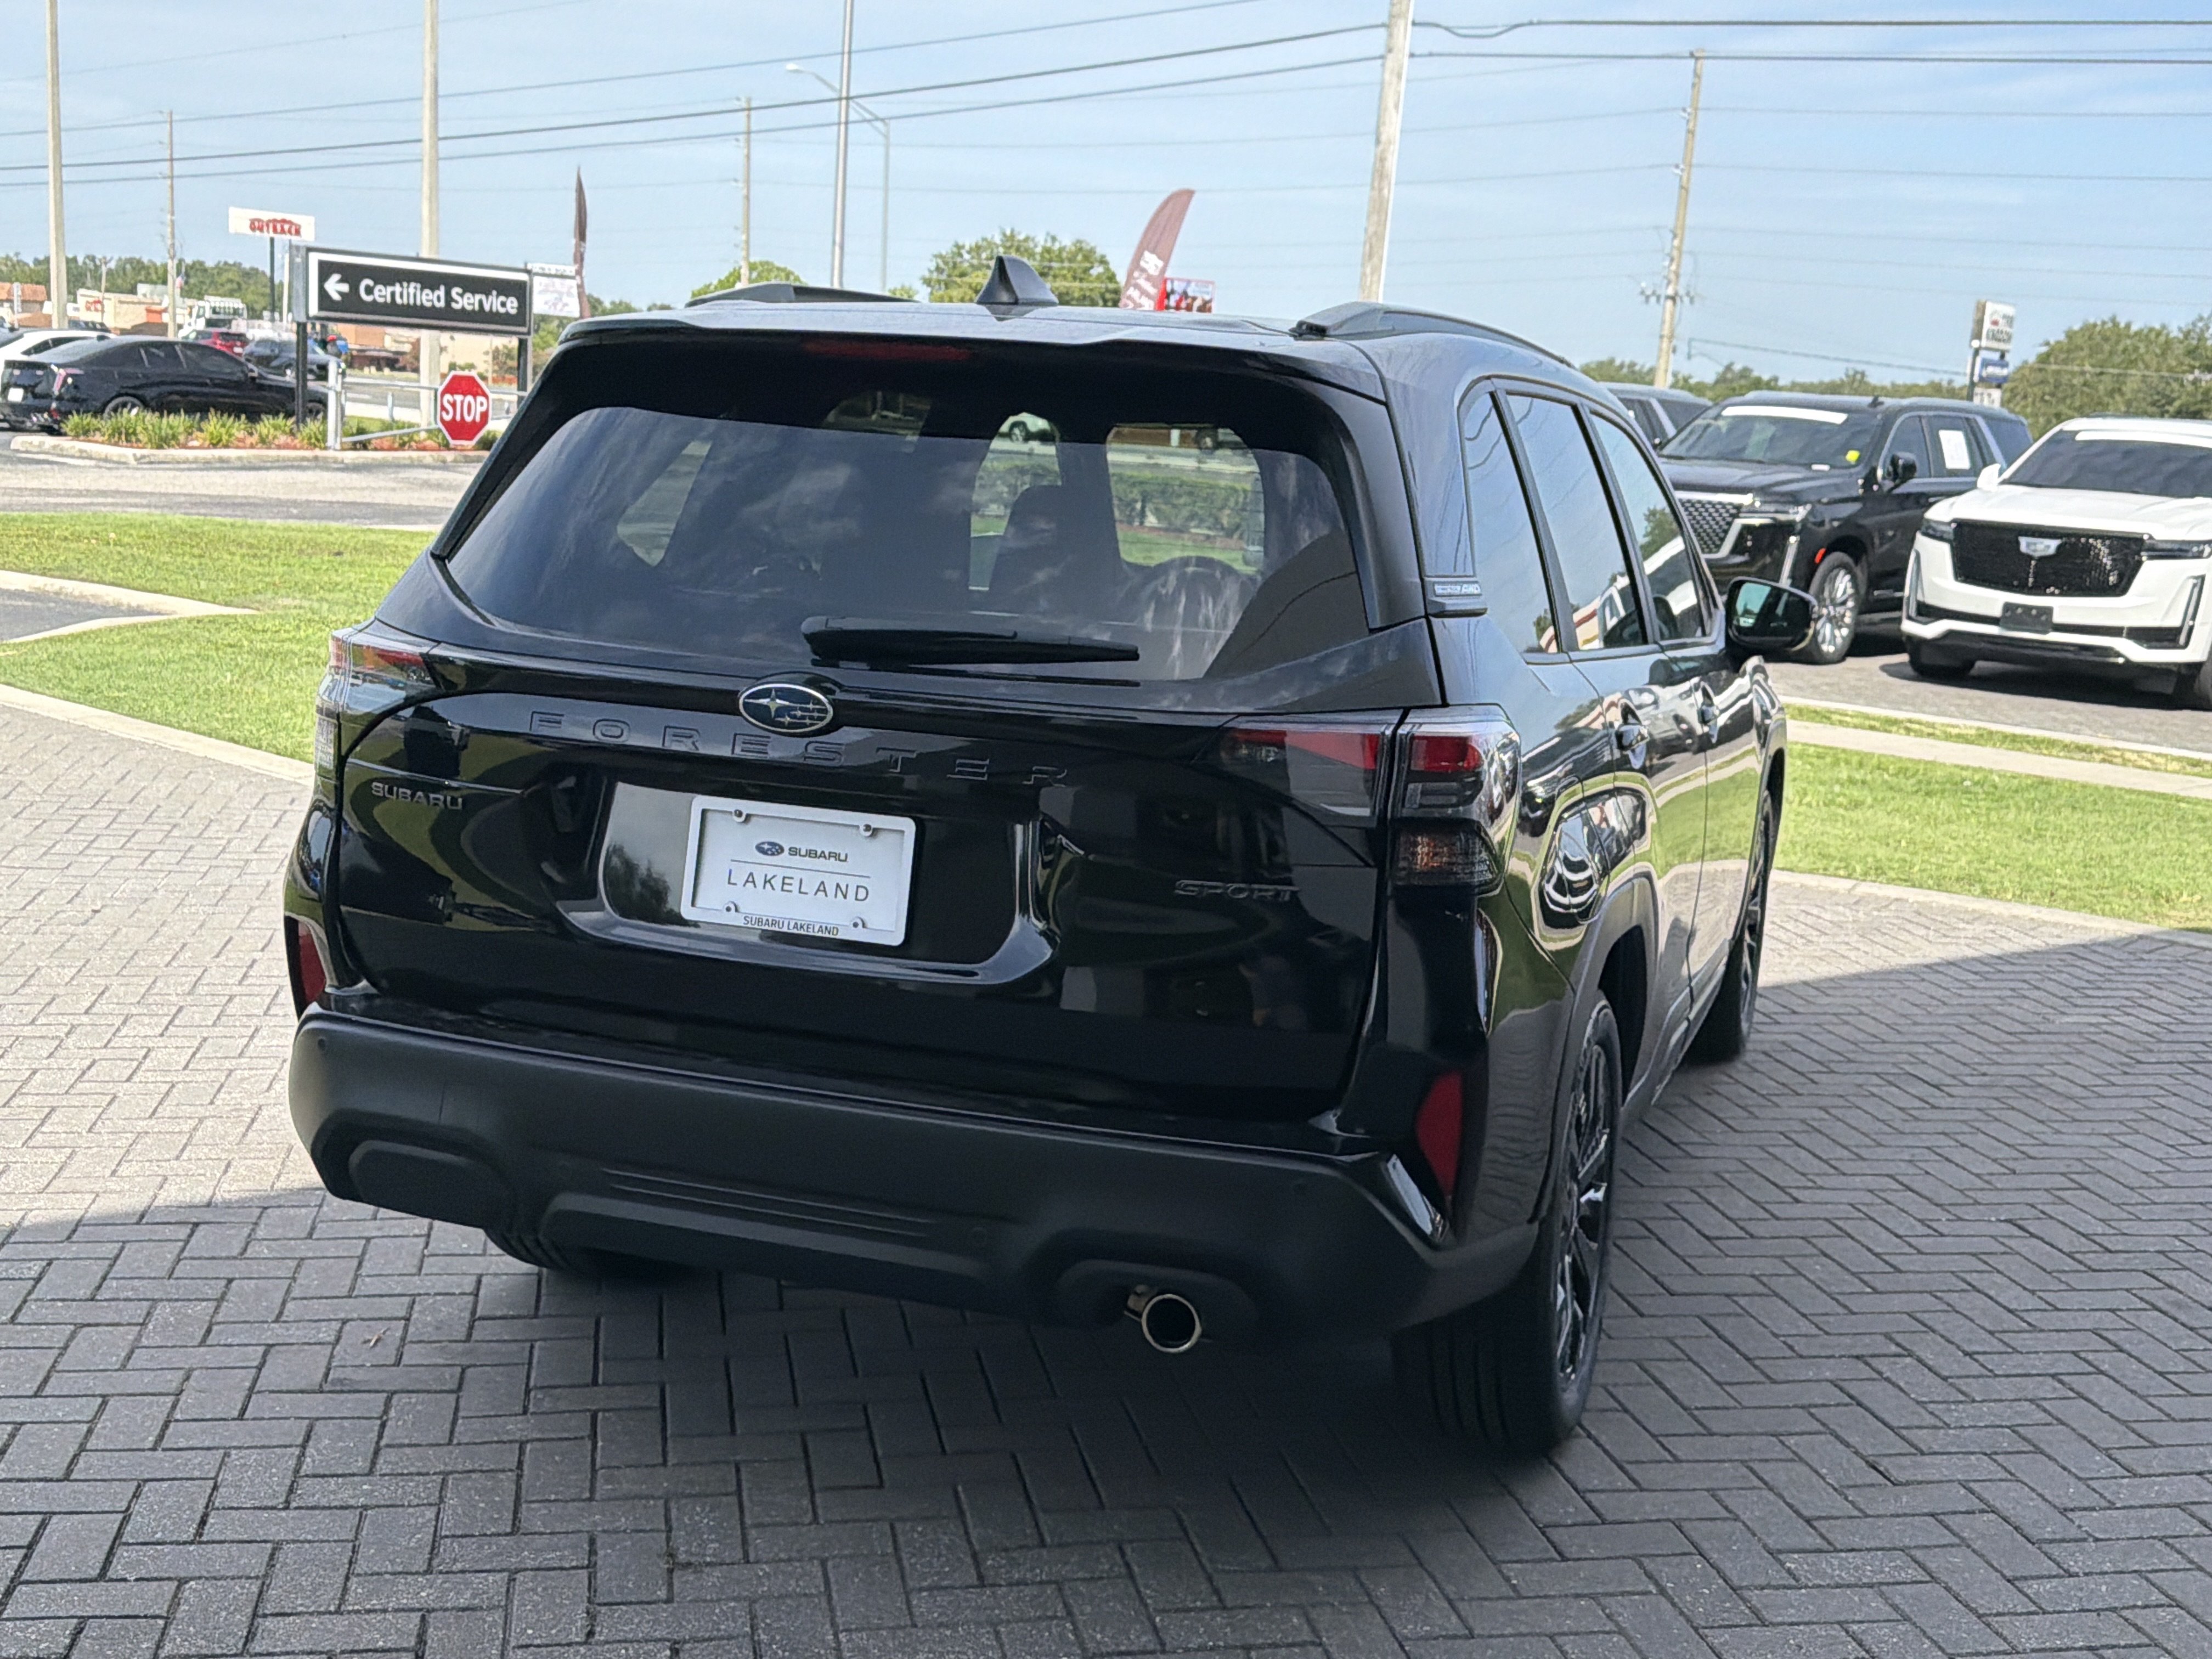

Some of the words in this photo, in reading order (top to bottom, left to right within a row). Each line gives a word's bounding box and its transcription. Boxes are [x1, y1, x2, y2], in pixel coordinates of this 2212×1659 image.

[359, 278, 445, 308] Certified
[451, 286, 518, 314] Service
[442, 393, 488, 422] STOP
[529, 710, 1068, 787] FORESTER
[371, 782, 462, 810] SUBARU
[788, 847, 848, 862] SUBARU
[727, 868, 870, 902] LAKELAND
[1175, 879, 1300, 901] SPORT
[743, 915, 785, 929] SUBARU
[787, 920, 839, 936] LAKELAND
